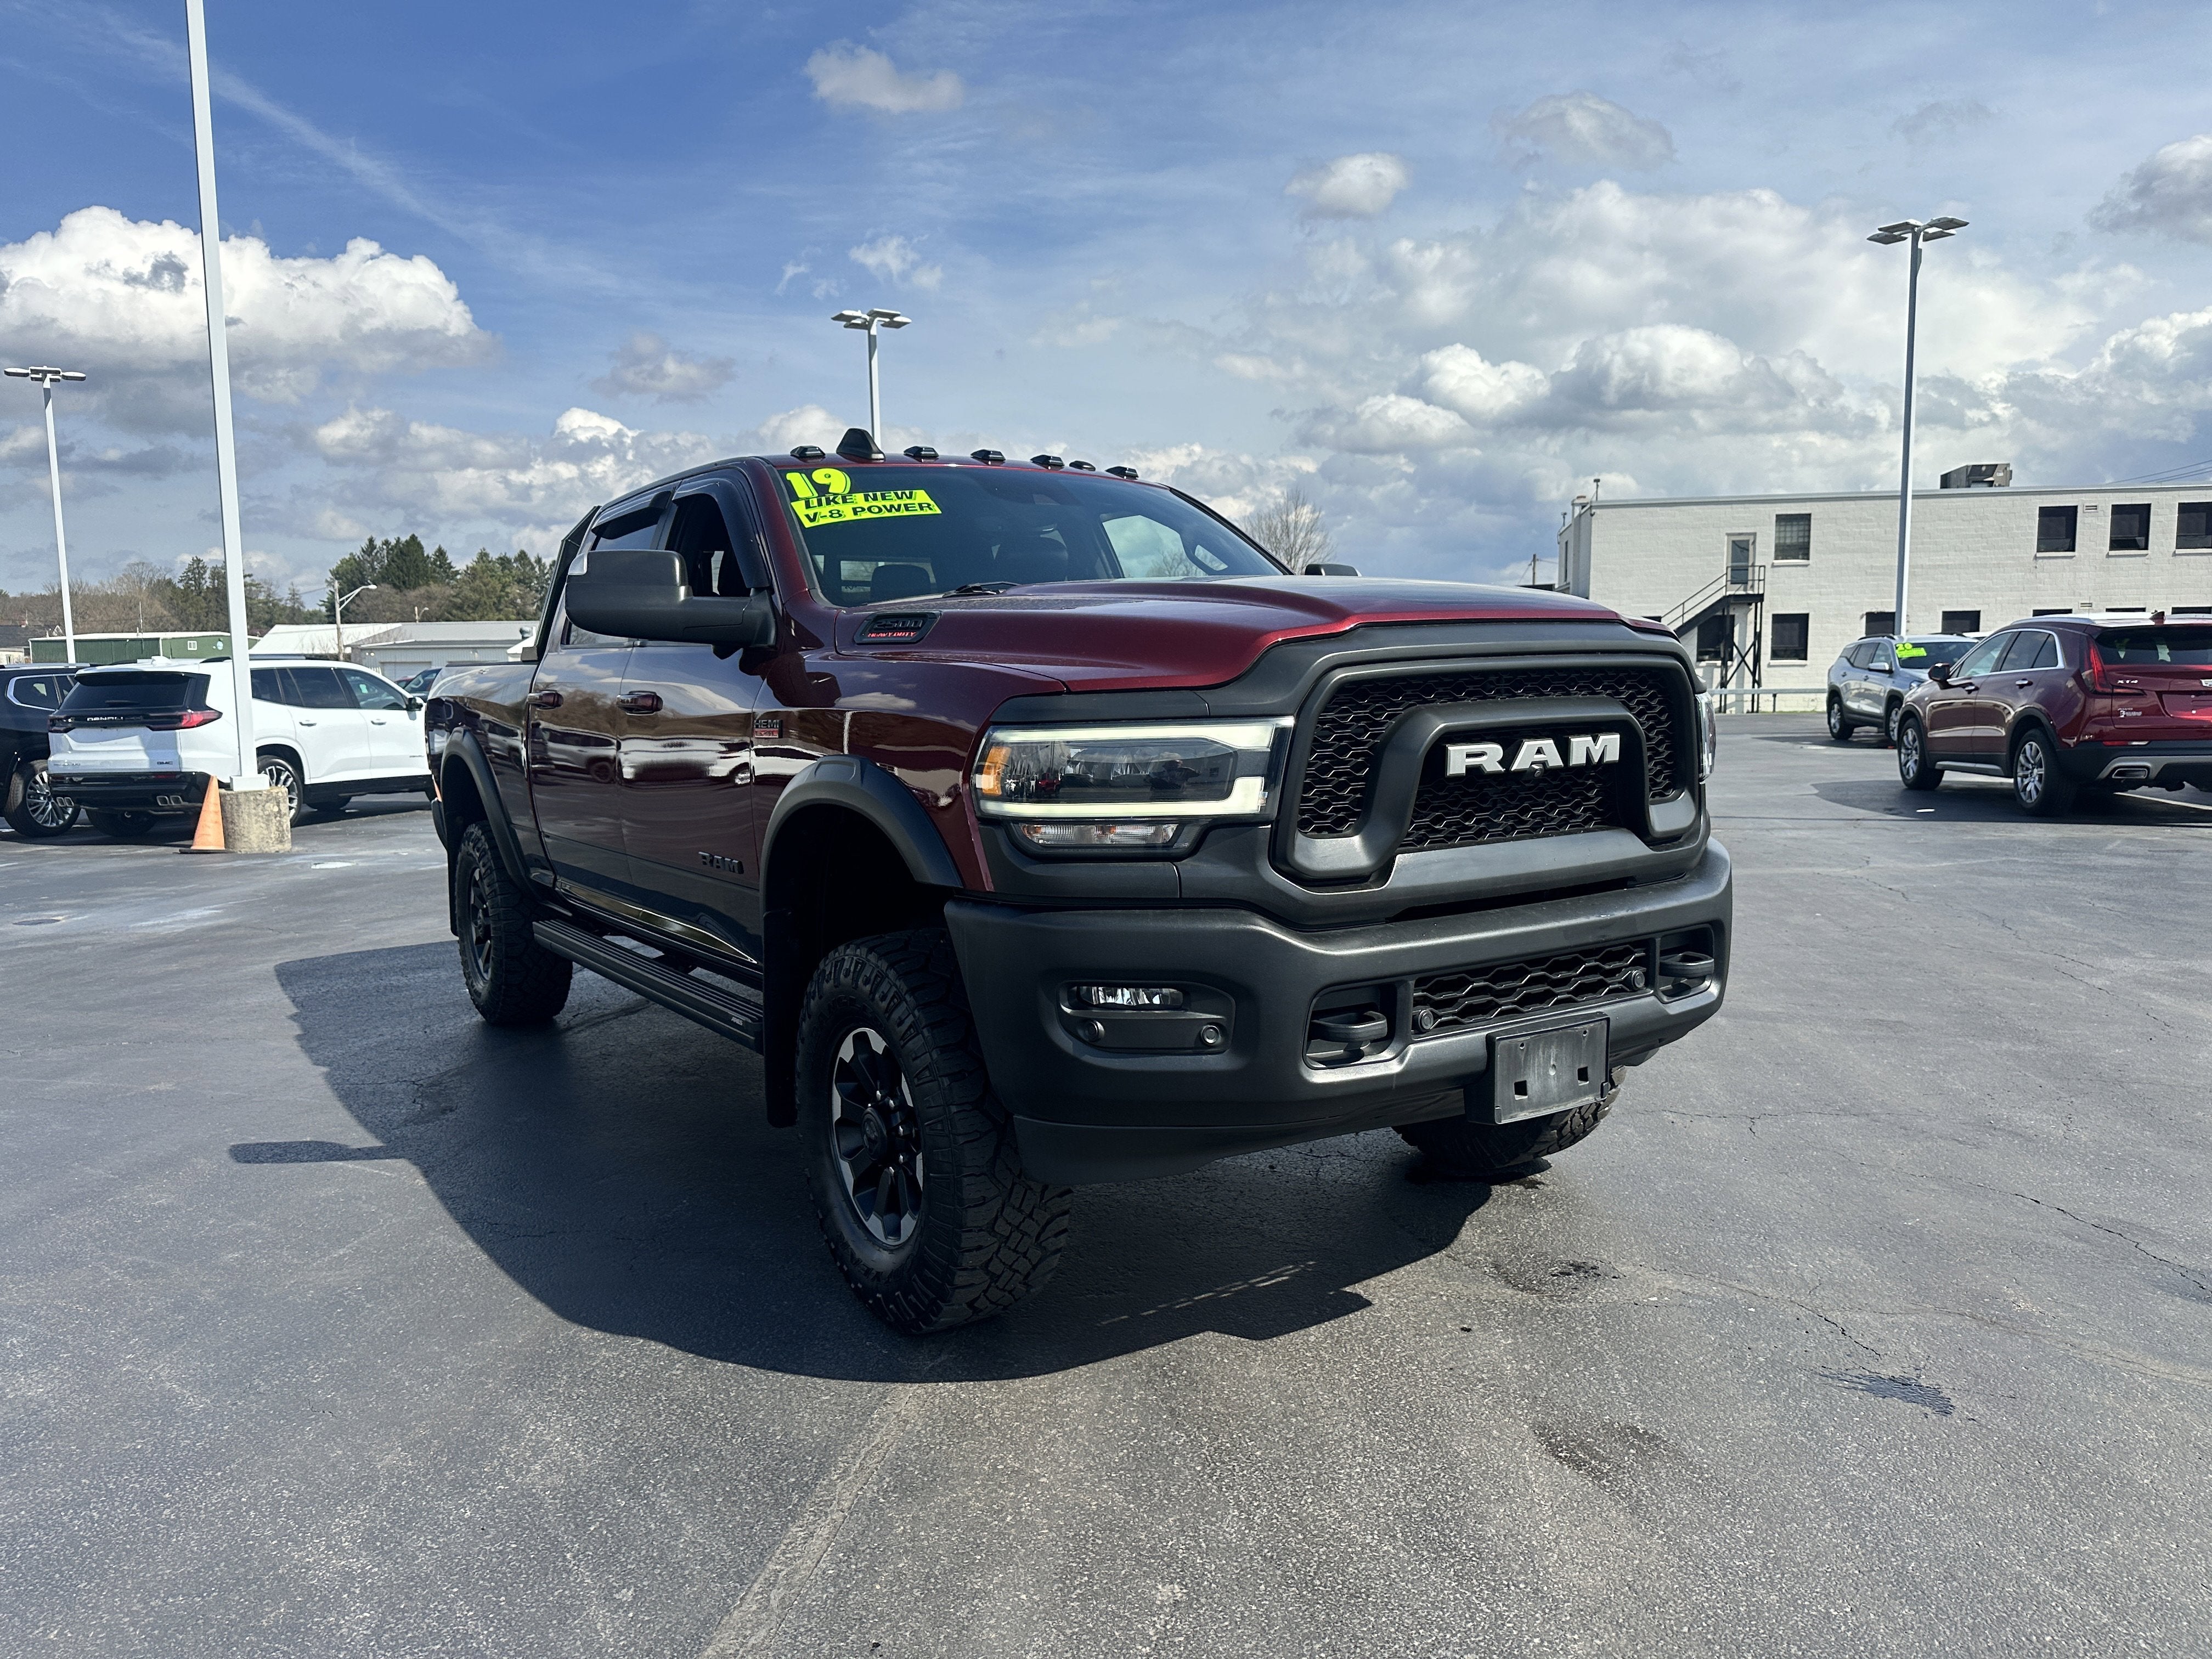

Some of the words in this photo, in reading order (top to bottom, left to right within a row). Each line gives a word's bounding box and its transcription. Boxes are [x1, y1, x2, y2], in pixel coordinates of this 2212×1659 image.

[786, 468, 851, 498] 19
[805, 494, 856, 509] LIKE
[863, 491, 916, 503] NEW
[804, 509, 845, 523] V-8
[853, 503, 934, 516] POWER
[874, 619, 923, 629] 2500
[753, 719, 780, 728] HEMI
[1446, 734, 1620, 777] RAM
[698, 851, 744, 874] RAM
